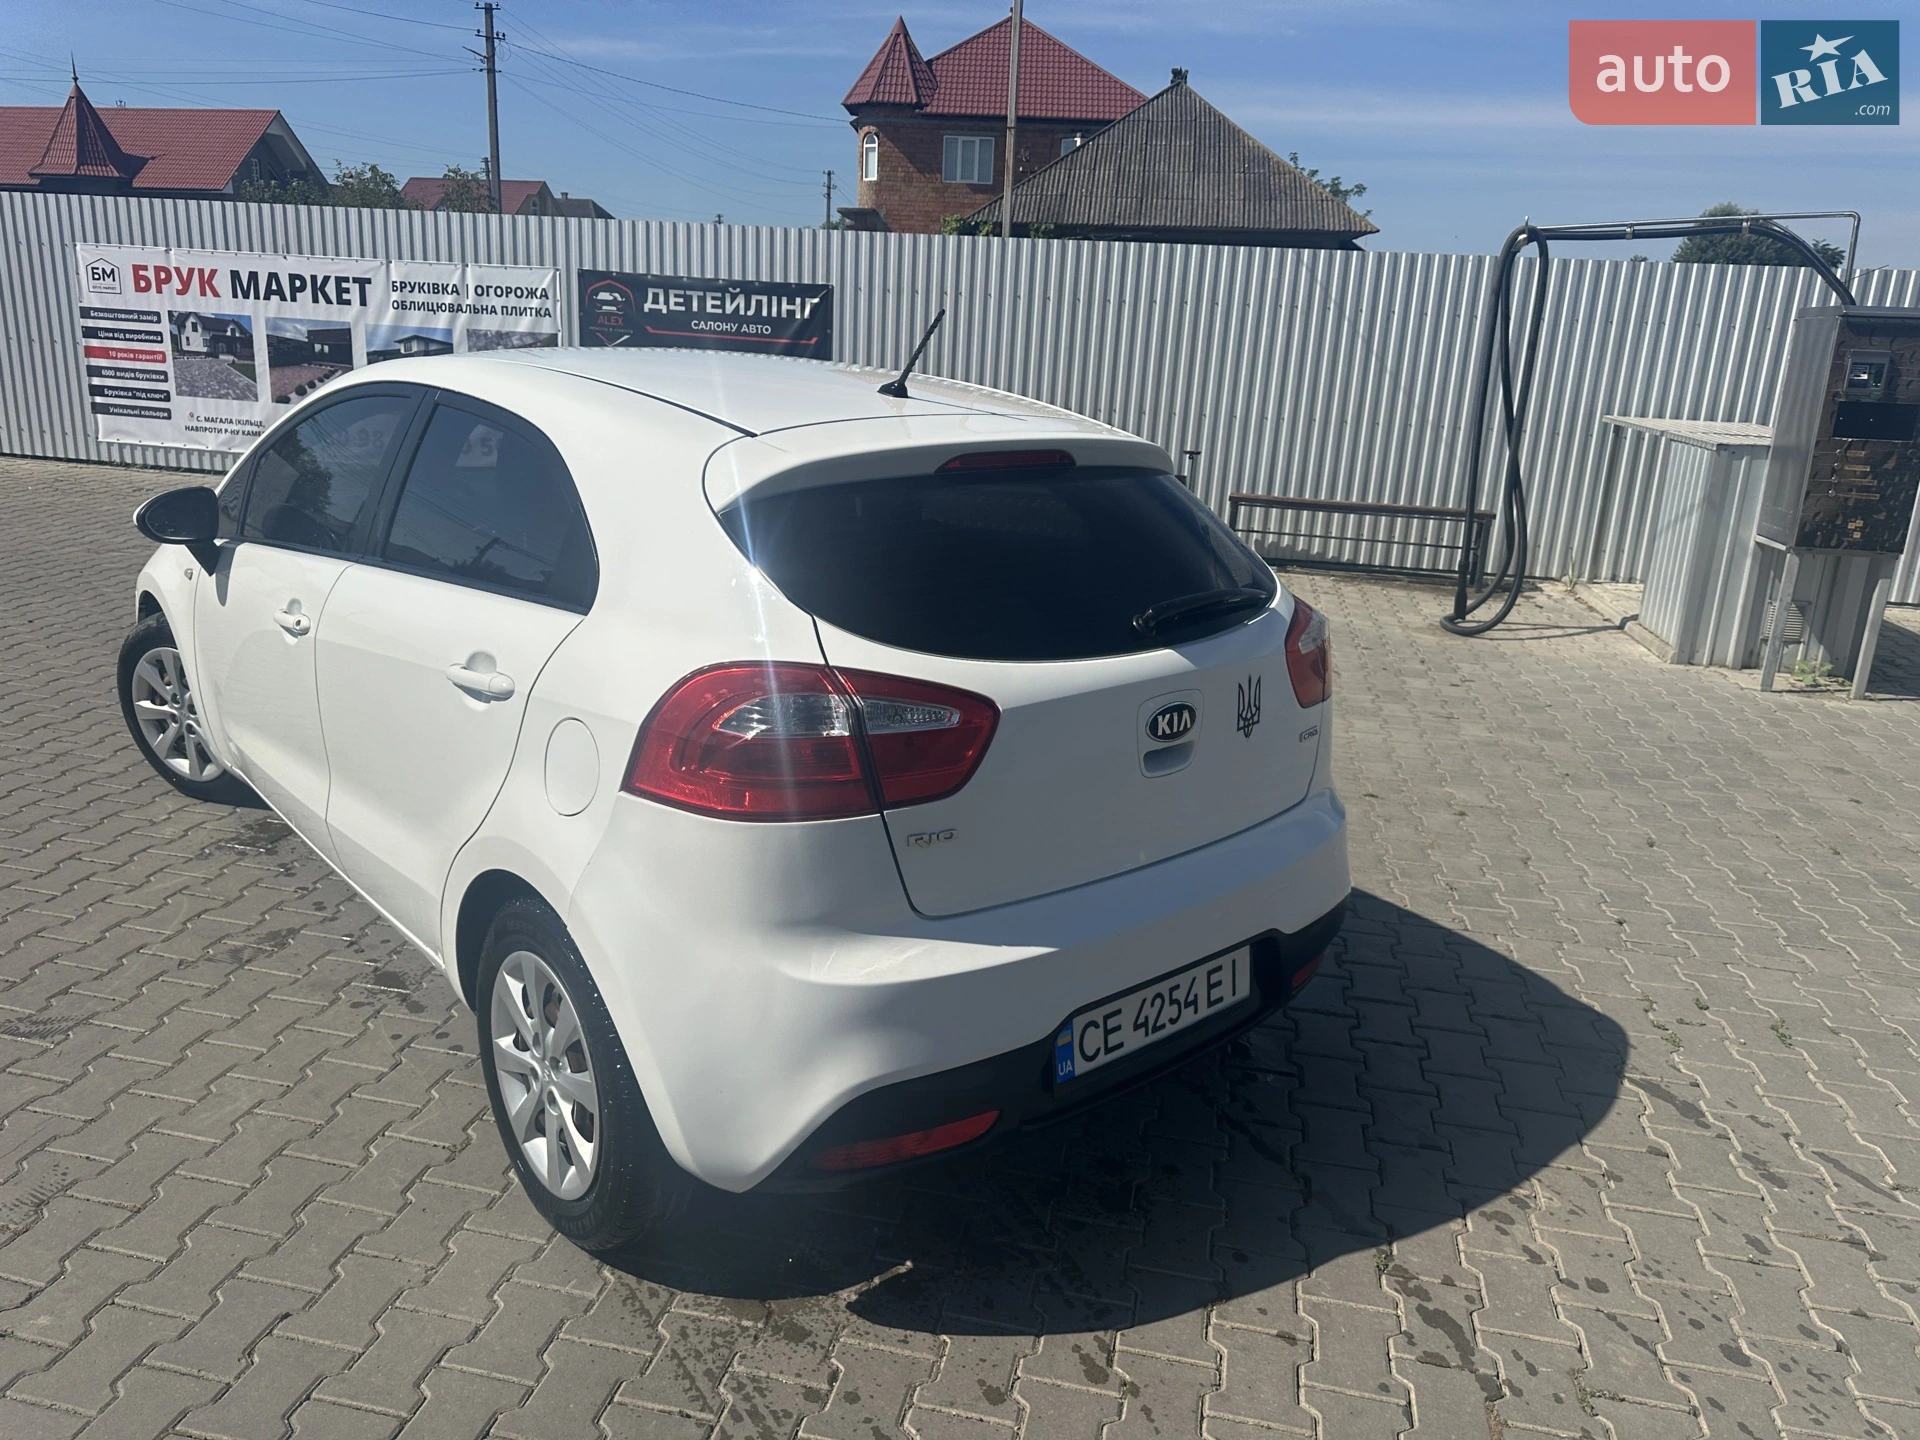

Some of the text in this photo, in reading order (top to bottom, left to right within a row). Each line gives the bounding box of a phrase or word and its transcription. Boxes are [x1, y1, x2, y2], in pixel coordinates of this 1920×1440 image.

[91, 266, 116, 282] БМ
[131, 263, 373, 307] БРУК МАРКЕТ
[391, 280, 550, 300] БРУКІВКА ОГОРОЖА
[391, 299, 553, 319] ОБЛИЦЮВАЛЬНА ПЛИТКА
[643, 287, 821, 320] ДЕТЕЙЛІНГ
[90, 310, 158, 323] Безкоштовний замір
[597, 315, 624, 326] ALEX
[691, 320, 772, 335] САЛОНУ АВТО
[97, 330, 162, 341] Ціни від виробника
[108, 350, 116, 358] 10
[117, 352, 134, 360] років
[116, 371, 135, 379] видів
[135, 371, 165, 380] бруківки
[104, 388, 132, 397] Бруківка
[109, 406, 169, 419] Унікальні кольори
[196, 415, 203, 423] С.
[203, 416, 234, 425] МАГАЛА
[184, 425, 223, 434] НАВПРОТИ
[224, 428, 241, 436] Р-НУ
[1156, 709, 1192, 736] KIA
[906, 828, 960, 848] RIO
[1078, 958, 1237, 1063] CE 4254 EI
[1058, 1059, 1073, 1076] UA
